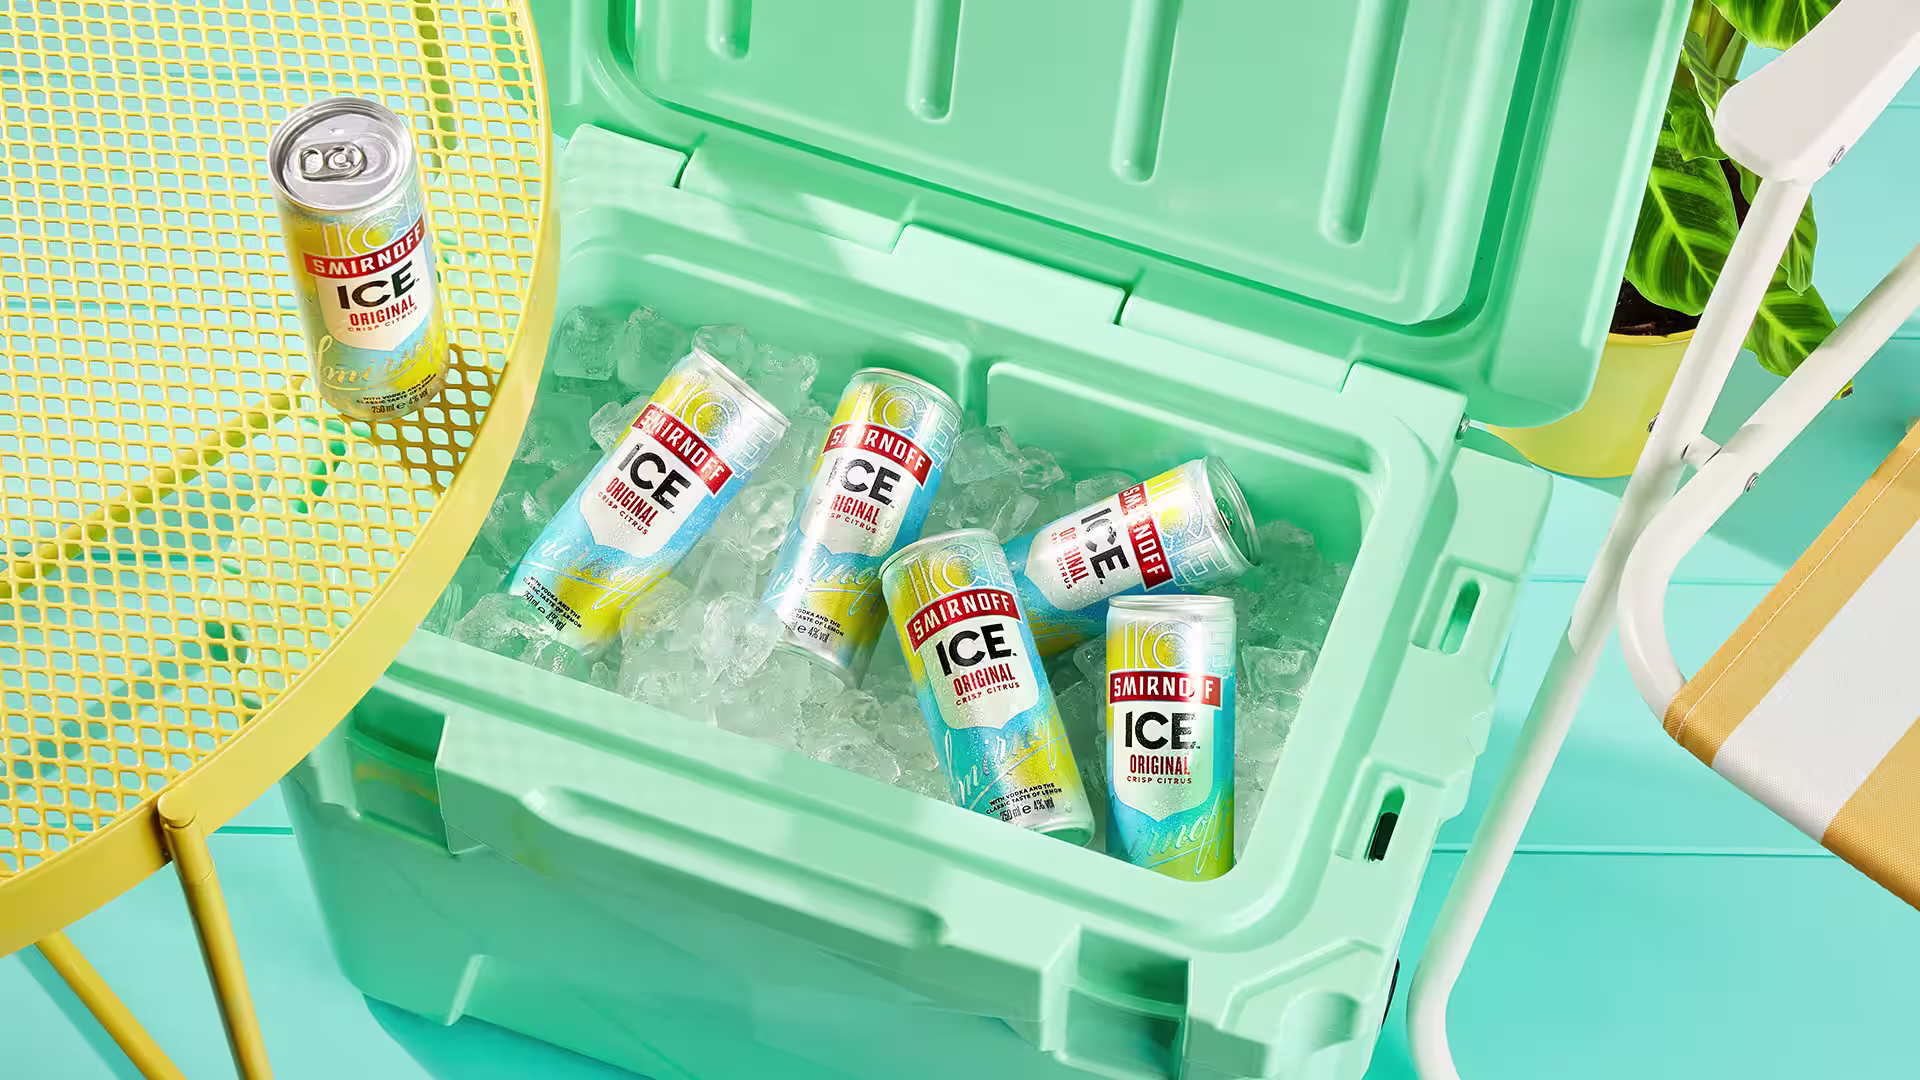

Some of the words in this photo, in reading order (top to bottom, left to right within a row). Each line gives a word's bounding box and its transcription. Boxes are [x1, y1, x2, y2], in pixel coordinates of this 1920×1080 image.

[313, 223, 421, 275] SMIRNOFF
[337, 260, 416, 309] ICE
[350, 295, 415, 326] ORIGINAL
[385, 306, 418, 327] CITRUS
[640, 408, 725, 482] SMIRNOFF
[831, 429, 926, 472] SRNOFF
[618, 442, 692, 511] ICE
[598, 491, 619, 511] CRISP
[619, 510, 649, 535] CITRUS
[605, 477, 659, 527] ORIGINAL
[830, 494, 881, 526] RIGINAL
[844, 516, 877, 534] CITRUS
[1056, 557, 1073, 590] CITRUS
[815, 614, 829, 622] AND
[824, 623, 844, 637] LEMON
[914, 593, 1010, 641] SMIRNOFF
[936, 623, 1014, 677] ICE
[954, 663, 1015, 697] ORIGINAL
[956, 691, 982, 707] CRISP
[986, 681, 1020, 695] CITRUS
[1113, 675, 1214, 700] SMIRNOF
[1126, 775, 1153, 784] CRISP
[1156, 777, 1193, 785] CITRUS
[1129, 754, 1191, 775] ORIGINAL
[1006, 788, 1028, 799] VODKA
[1029, 784, 1043, 792] AND
[1041, 788, 1063, 796] LEMON
